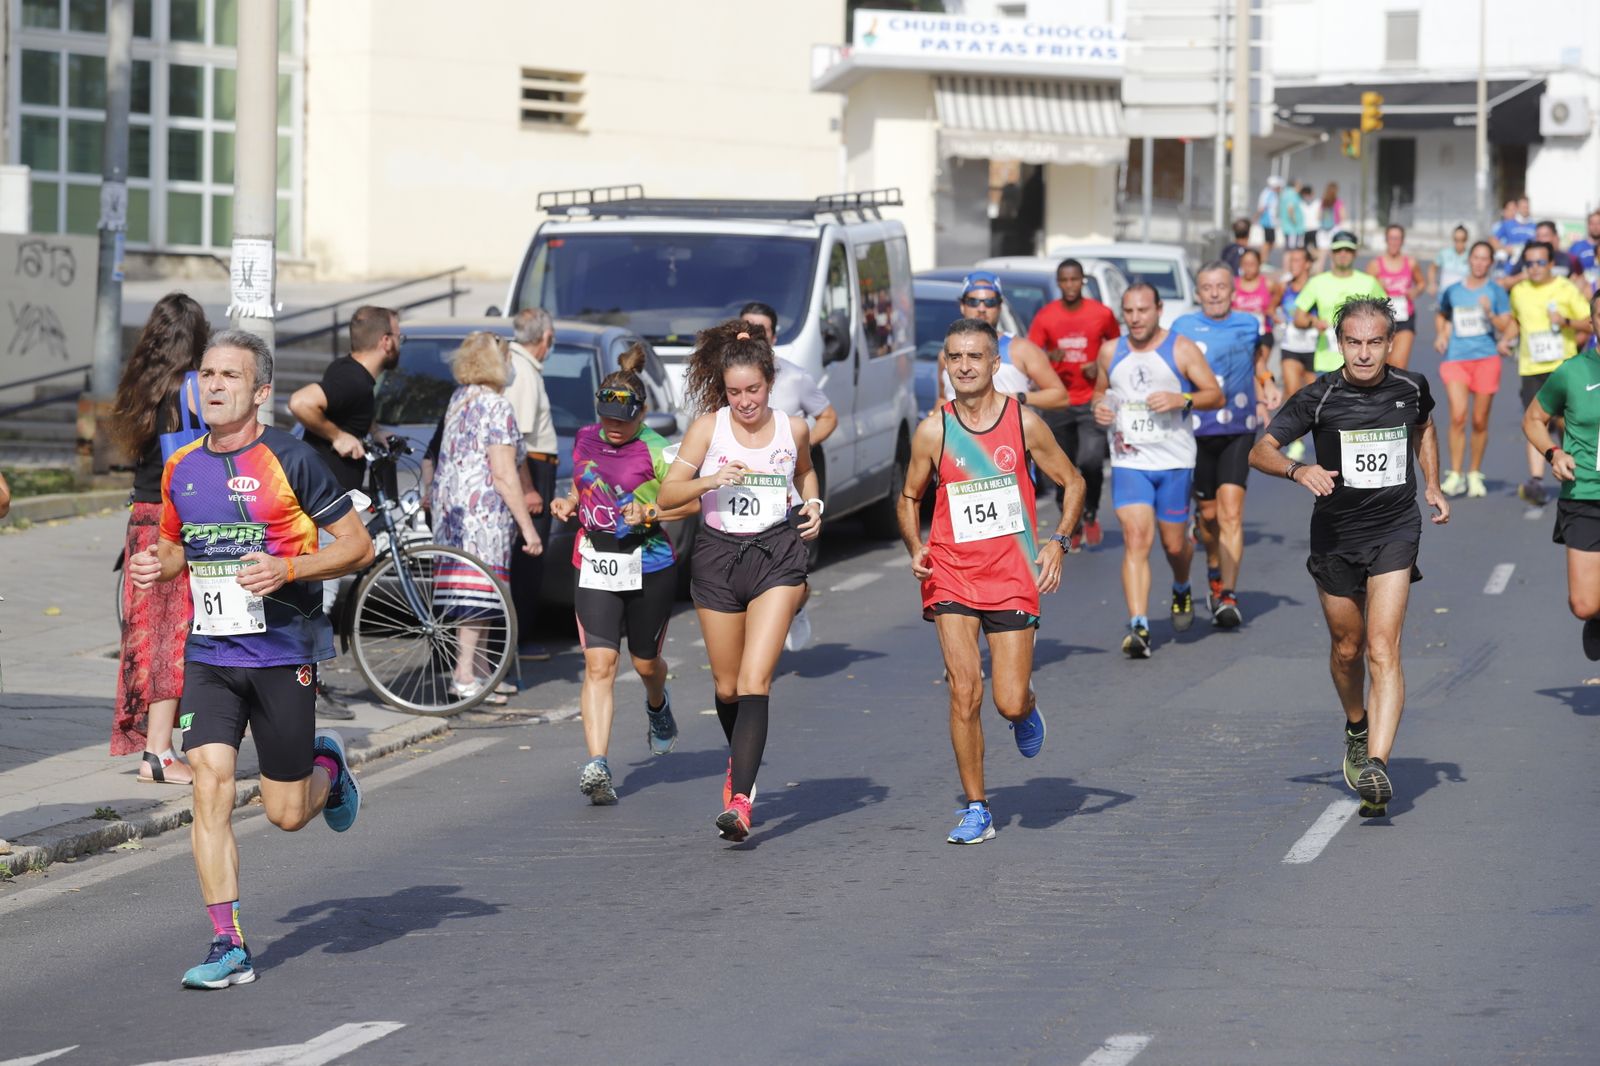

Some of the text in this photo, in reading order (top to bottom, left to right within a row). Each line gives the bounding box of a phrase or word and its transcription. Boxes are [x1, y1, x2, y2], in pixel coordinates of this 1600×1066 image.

[888, 18, 1001, 36] CHURROS
[920, 38, 1119, 60] PATATAS FRITAS
[1131, 418, 1154, 432] 479
[1355, 432, 1377, 442] VUELTA
[1379, 432, 1384, 441] A
[1385, 430, 1404, 441] HUELVA
[1355, 453, 1388, 472] 582
[232, 479, 255, 489] KIA
[759, 476, 782, 486] HUELVA
[960, 481, 983, 494] VUELTA
[984, 481, 990, 490] A
[990, 477, 1013, 489] HUELVA
[228, 494, 257, 503] VEYSER
[728, 497, 760, 516] 120
[963, 501, 998, 525] 154
[218, 565, 224, 576] A
[203, 591, 223, 616] 61
